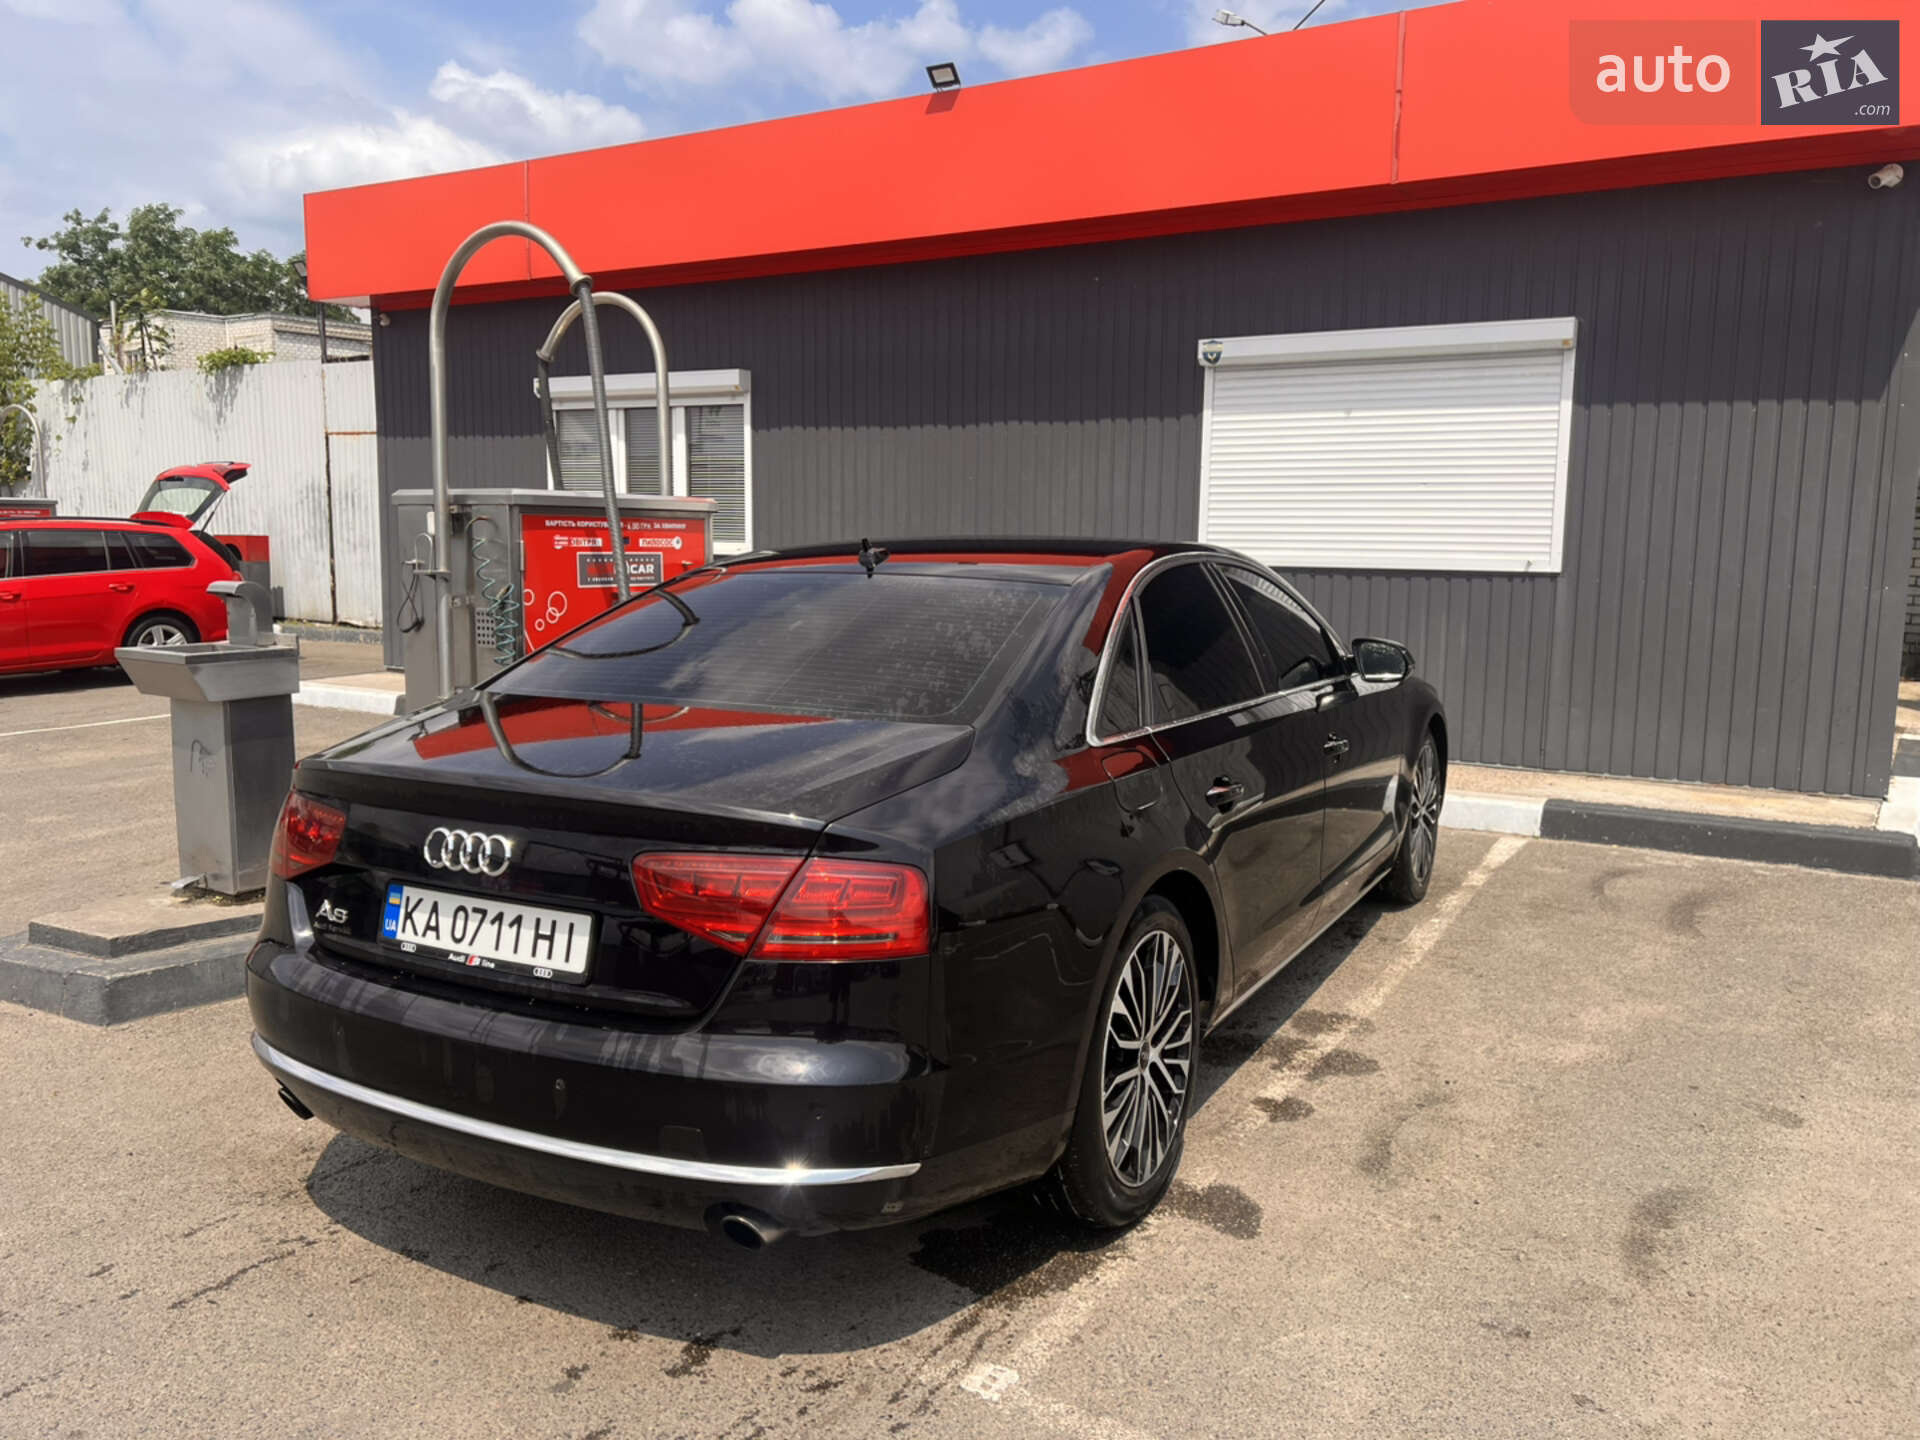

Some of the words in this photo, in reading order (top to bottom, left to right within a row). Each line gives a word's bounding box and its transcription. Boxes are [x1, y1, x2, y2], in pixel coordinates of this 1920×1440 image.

[385, 918, 397, 932] UA
[401, 895, 441, 941] KA
[450, 904, 524, 955] 0711
[531, 917, 576, 964] HI
